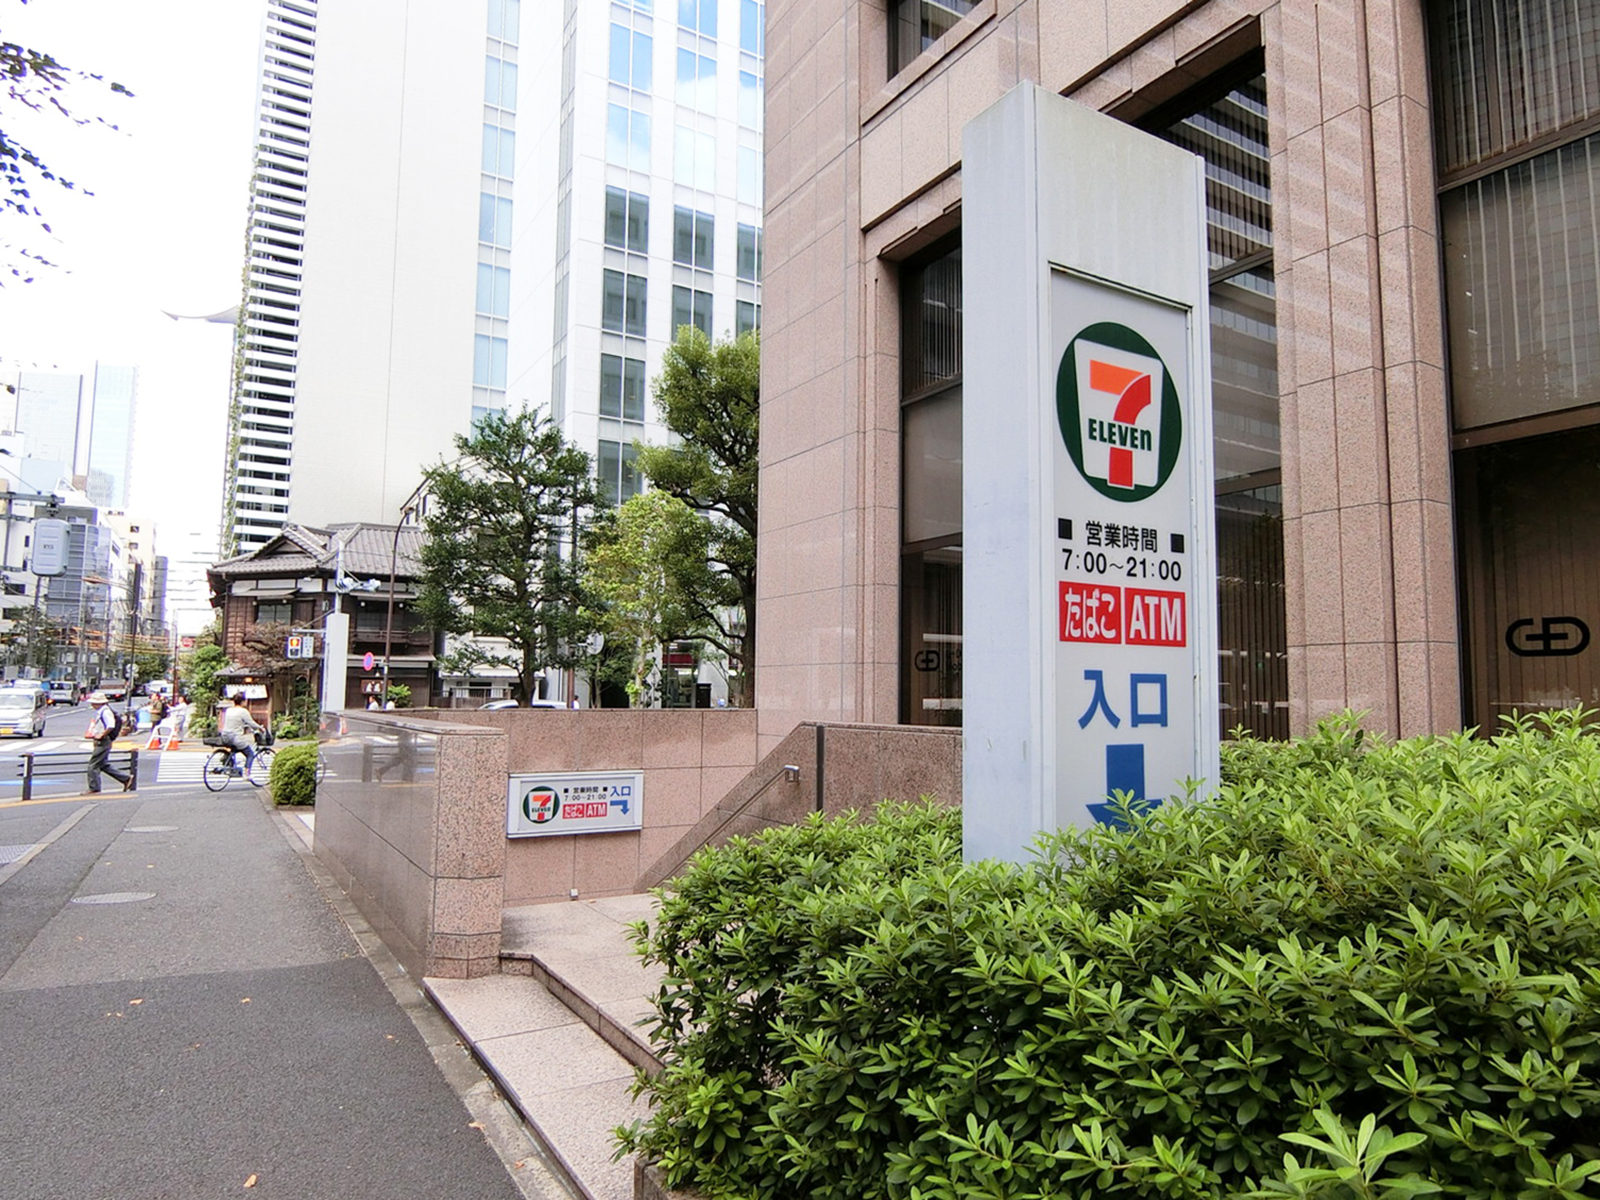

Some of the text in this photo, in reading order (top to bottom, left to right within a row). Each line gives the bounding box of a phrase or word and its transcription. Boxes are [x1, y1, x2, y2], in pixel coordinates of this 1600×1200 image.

[1089, 359, 1152, 488] 7
[1085, 520, 1158, 553] 営業時間
[1064, 587, 1117, 639] たばこ
[1129, 594, 1183, 642] ATM
[1077, 669, 1169, 730] 入口
[610, 786, 631, 796] 入口
[533, 795, 551, 821] 7
[564, 804, 584, 818] たばこ
[587, 804, 606, 816] ATM
